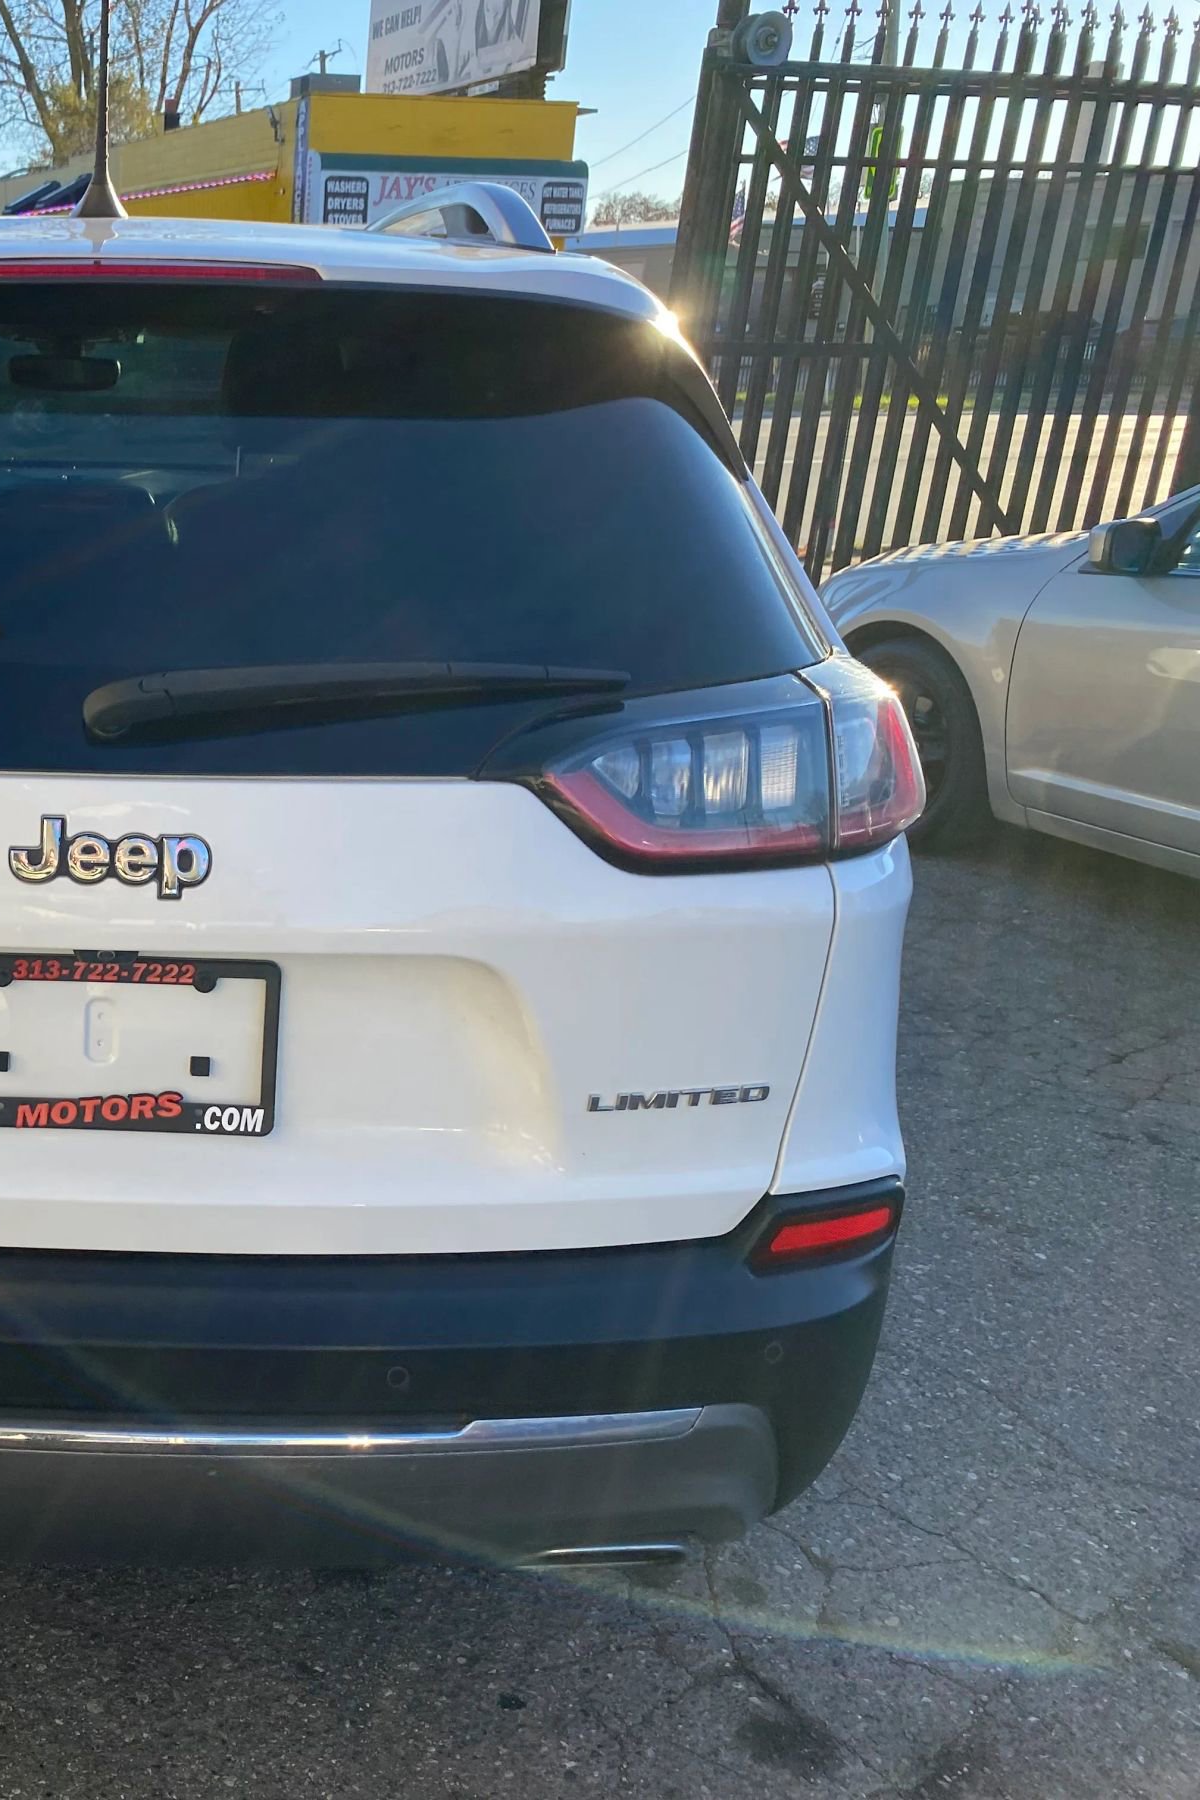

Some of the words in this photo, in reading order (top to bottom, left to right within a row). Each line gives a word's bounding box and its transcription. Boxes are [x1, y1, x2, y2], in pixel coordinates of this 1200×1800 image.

[373, 21, 383, 40] WE
[385, 14, 400, 35] CAN
[400, 4, 422, 30] HELP!
[384, 48, 424, 76] MOTORS
[326, 180, 367, 194] WASHERS
[327, 198, 365, 210] DRYERS
[8, 814, 212, 900] Jeep
[13, 959, 196, 983] 313-722-7222
[587, 1081, 770, 1112] LIMITED
[16, 1091, 183, 1128] MOTORS
[195, 1106, 265, 1133] .COM
